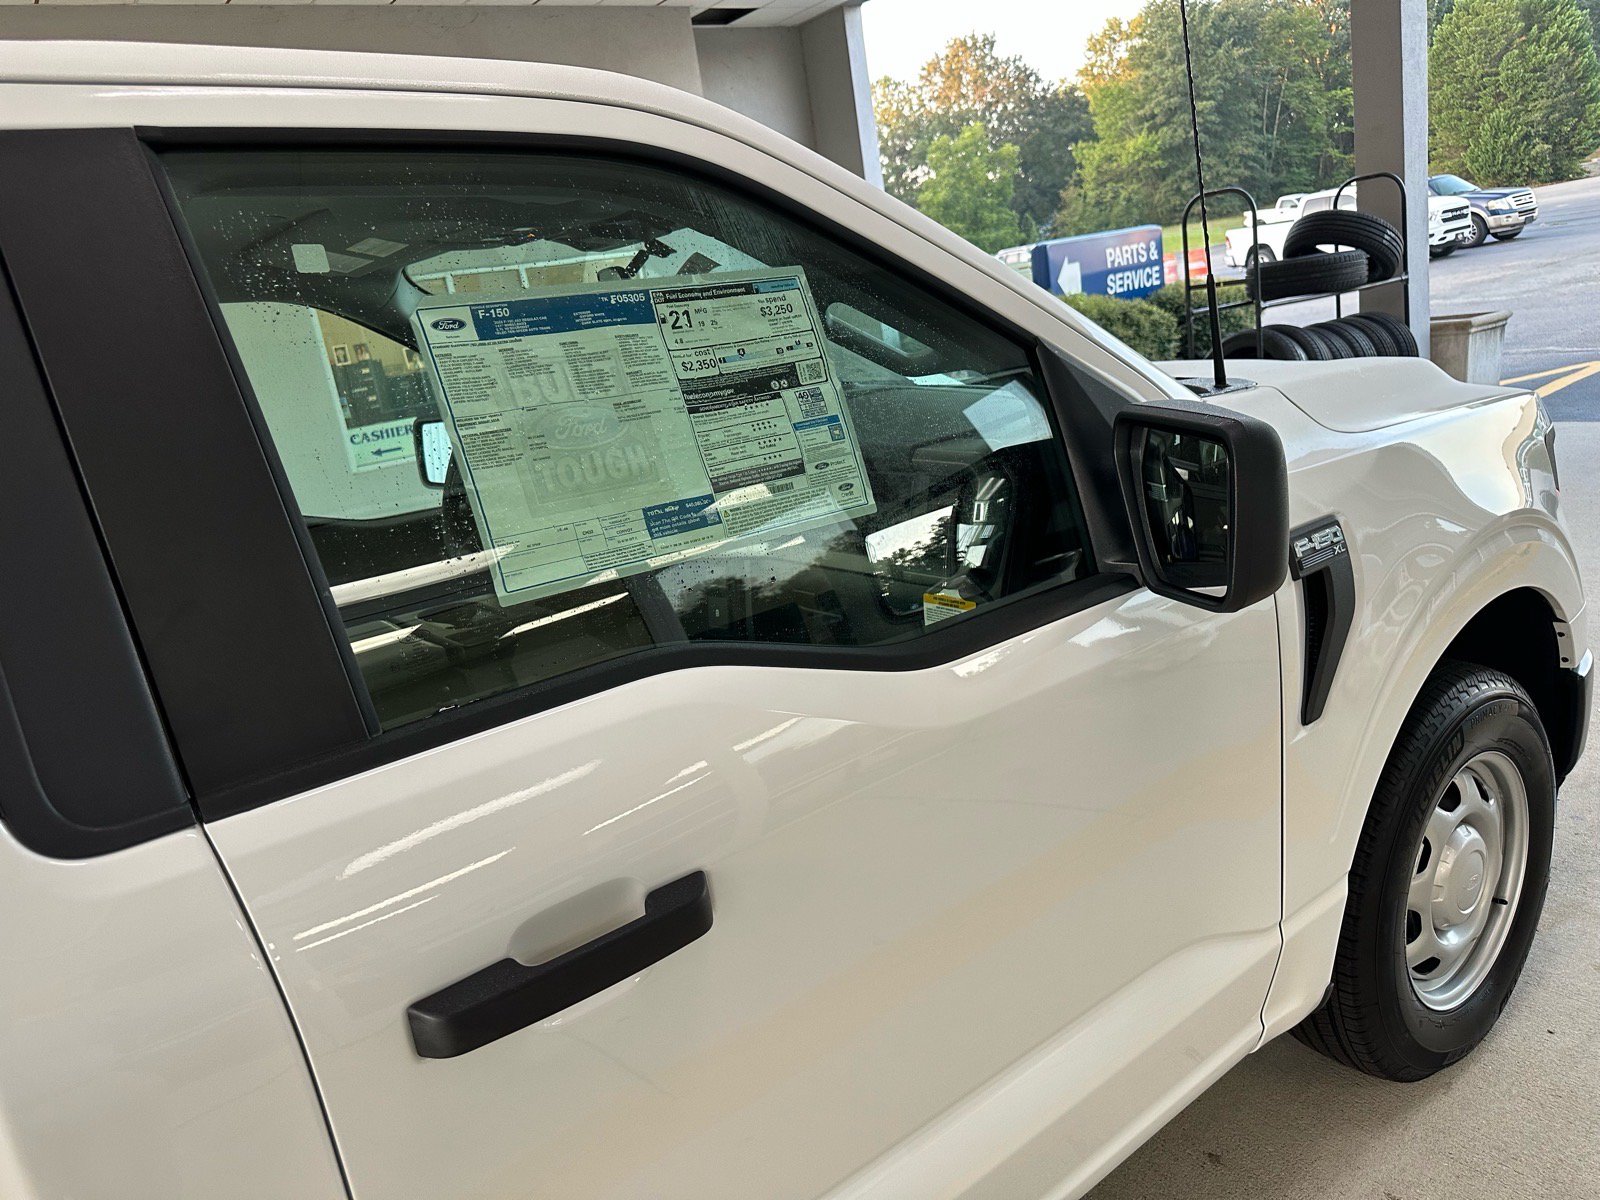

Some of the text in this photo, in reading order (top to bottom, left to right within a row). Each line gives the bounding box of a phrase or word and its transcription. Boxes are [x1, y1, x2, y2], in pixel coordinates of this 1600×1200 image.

[1105, 240, 1159, 269] PARTS &
[1106, 265, 1161, 295] SERVICE
[679, 291, 702, 301] Economy
[713, 286, 746, 296] Environment
[765, 293, 787, 305] spend
[478, 307, 510, 319] F-150
[760, 303, 793, 318] $3,250
[438, 320, 460, 330] Ford
[668, 309, 693, 330] 21
[694, 348, 711, 358] cost
[681, 358, 717, 373] $2,350
[350, 424, 414, 445] CASHIER
[552, 417, 608, 440] Ford
[530, 443, 654, 492] TOUGH
[1293, 524, 1344, 558] F-150
[1333, 540, 1347, 555] XL
